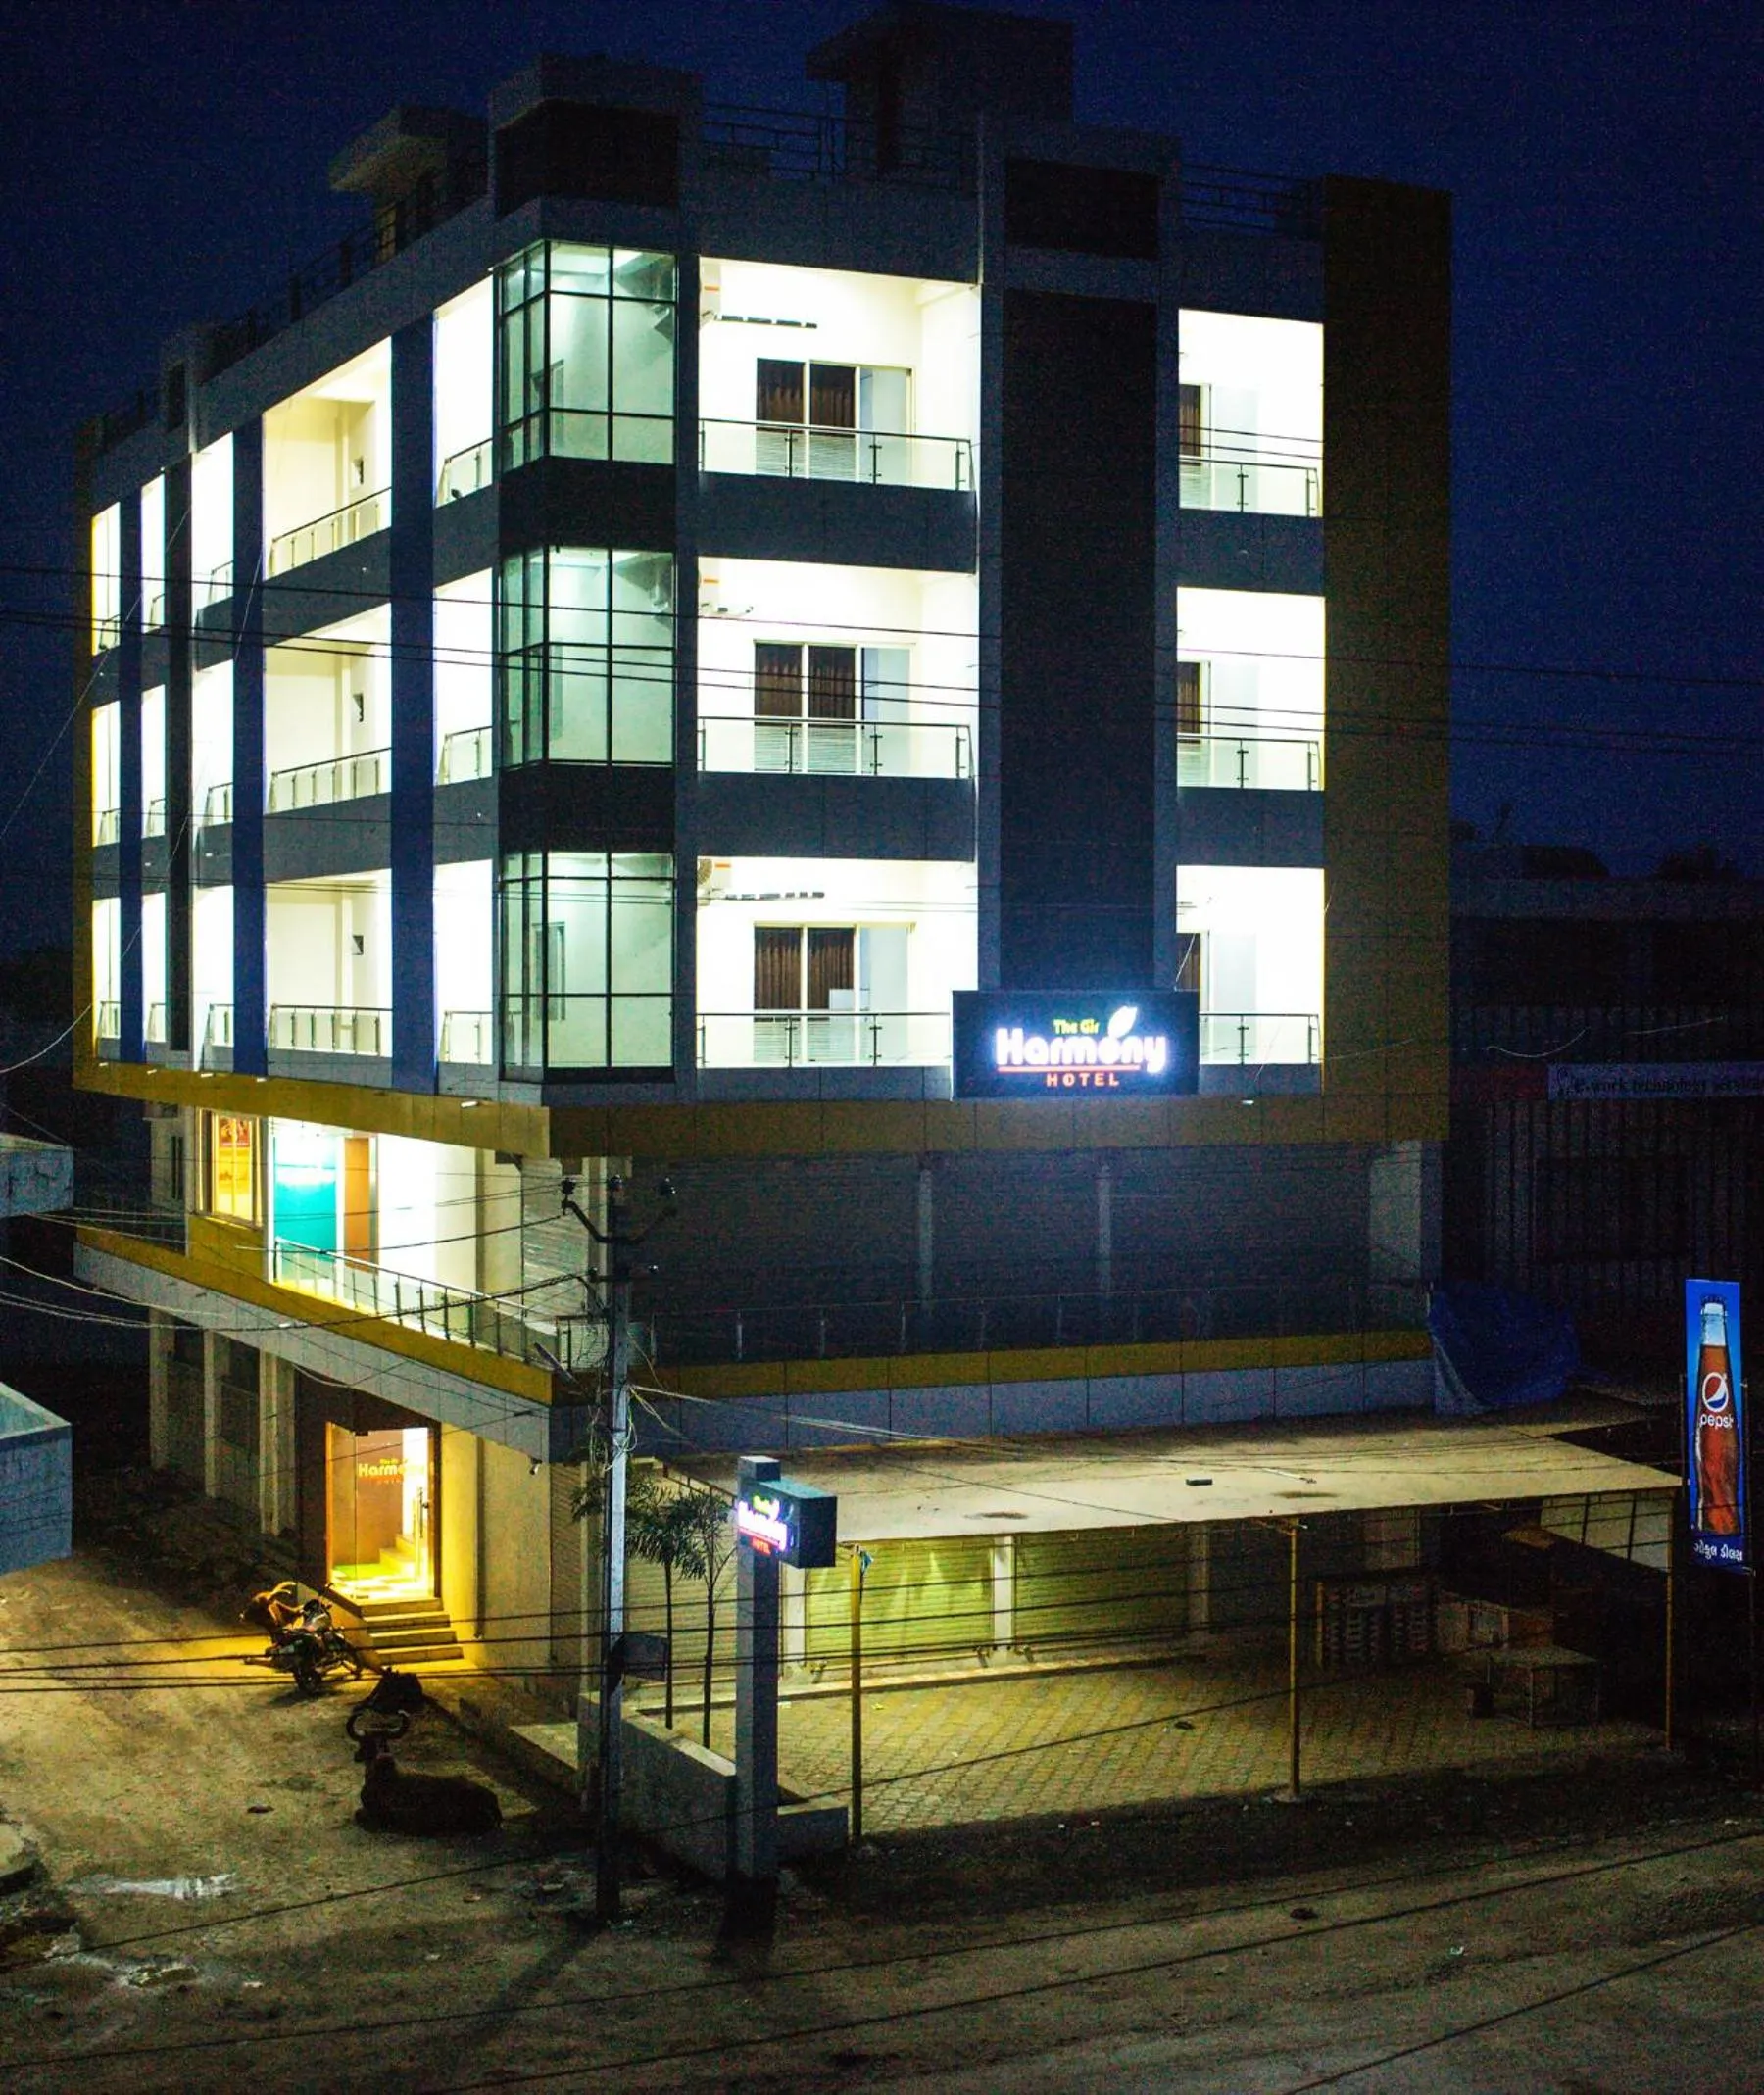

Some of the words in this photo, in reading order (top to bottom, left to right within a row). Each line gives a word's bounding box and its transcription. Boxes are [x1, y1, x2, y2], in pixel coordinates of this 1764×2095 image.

[1054, 1018, 1078, 1035] The
[995, 1027, 1166, 1073] Harmony
[1046, 1073, 1119, 1087] HOTEL
